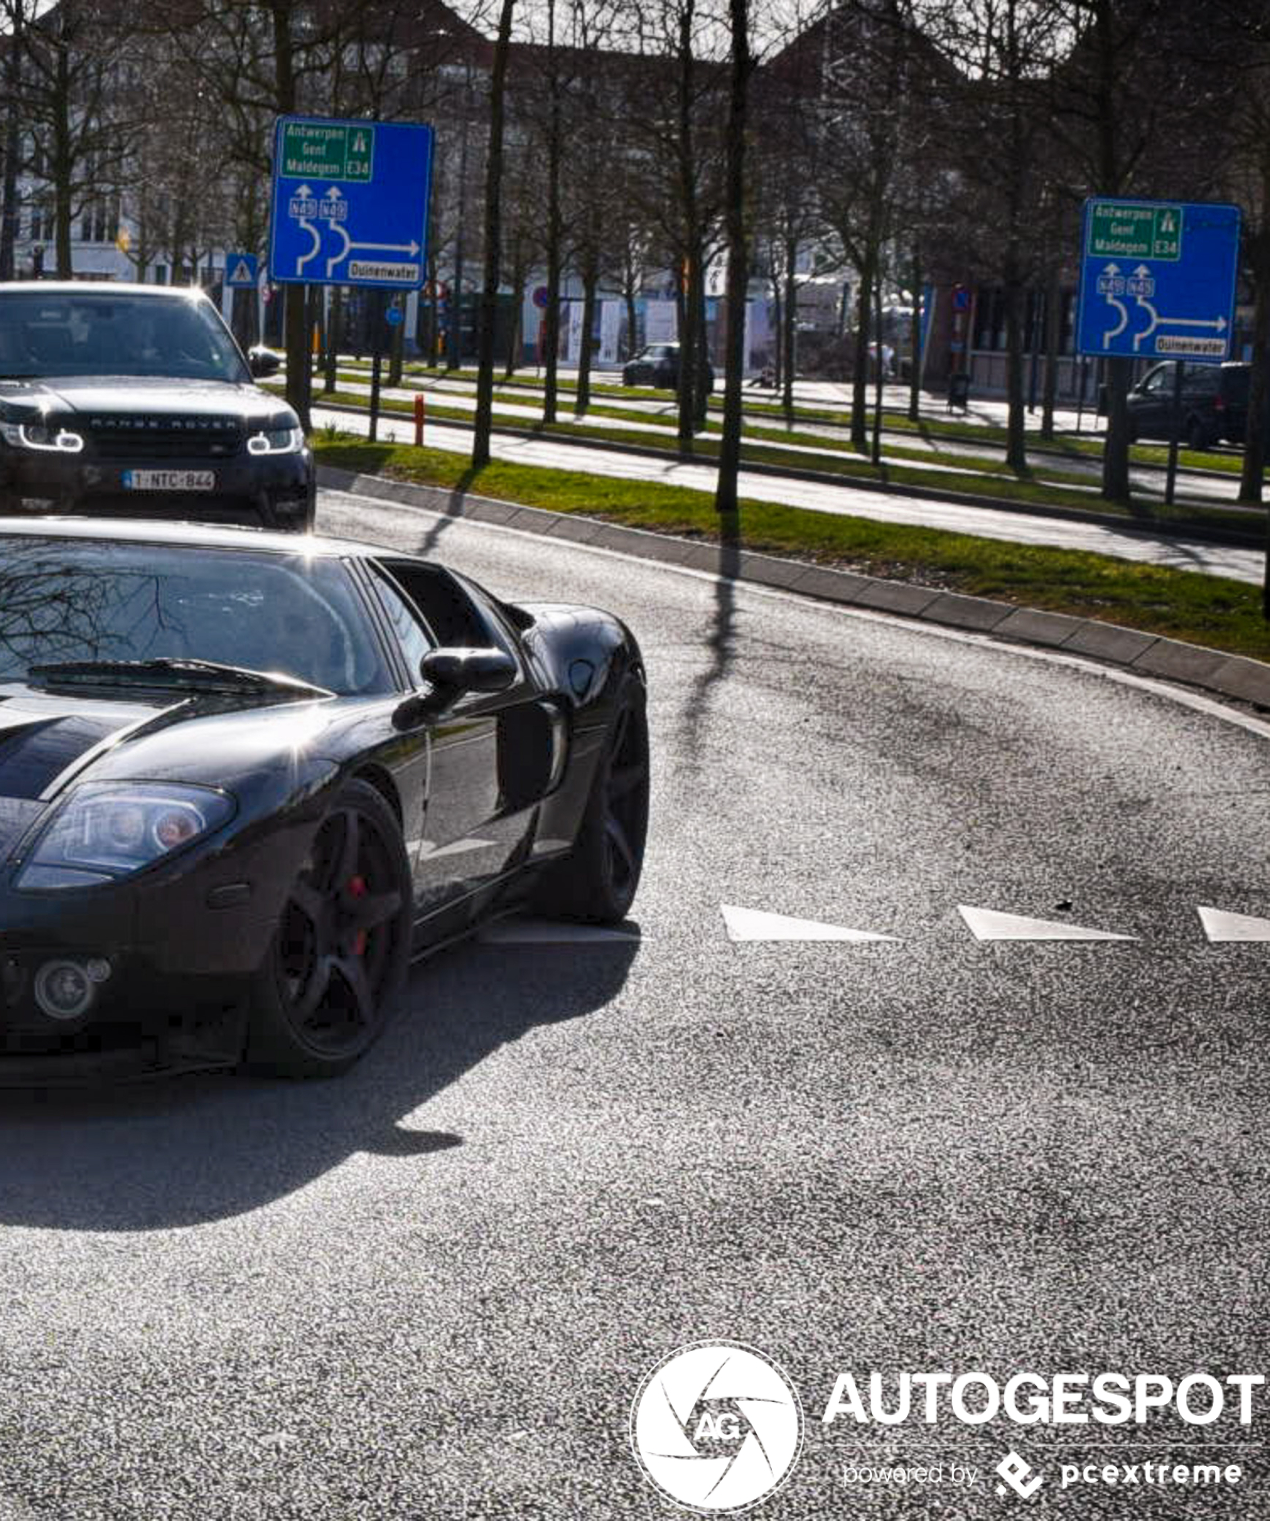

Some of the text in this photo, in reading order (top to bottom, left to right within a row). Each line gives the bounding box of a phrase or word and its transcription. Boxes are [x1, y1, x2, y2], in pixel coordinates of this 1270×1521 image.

[287, 124, 345, 141] Antwerpen
[303, 142, 326, 156] Gent
[286, 158, 340, 177] Maldegem
[347, 160, 369, 175] E34
[292, 201, 315, 217] N49
[322, 204, 345, 218] N49
[1096, 205, 1153, 221] Antwerpen
[1110, 222, 1135, 236] Gent
[1094, 238, 1149, 257] Maldegem
[1155, 240, 1177, 254] E34
[351, 262, 417, 279] Duinenwater
[1099, 278, 1124, 294] N49
[1158, 337, 1225, 354] Duinenwater
[90, 418, 236, 429] RANGE ROVER
[135, 472, 213, 488] 1-NTC-844
